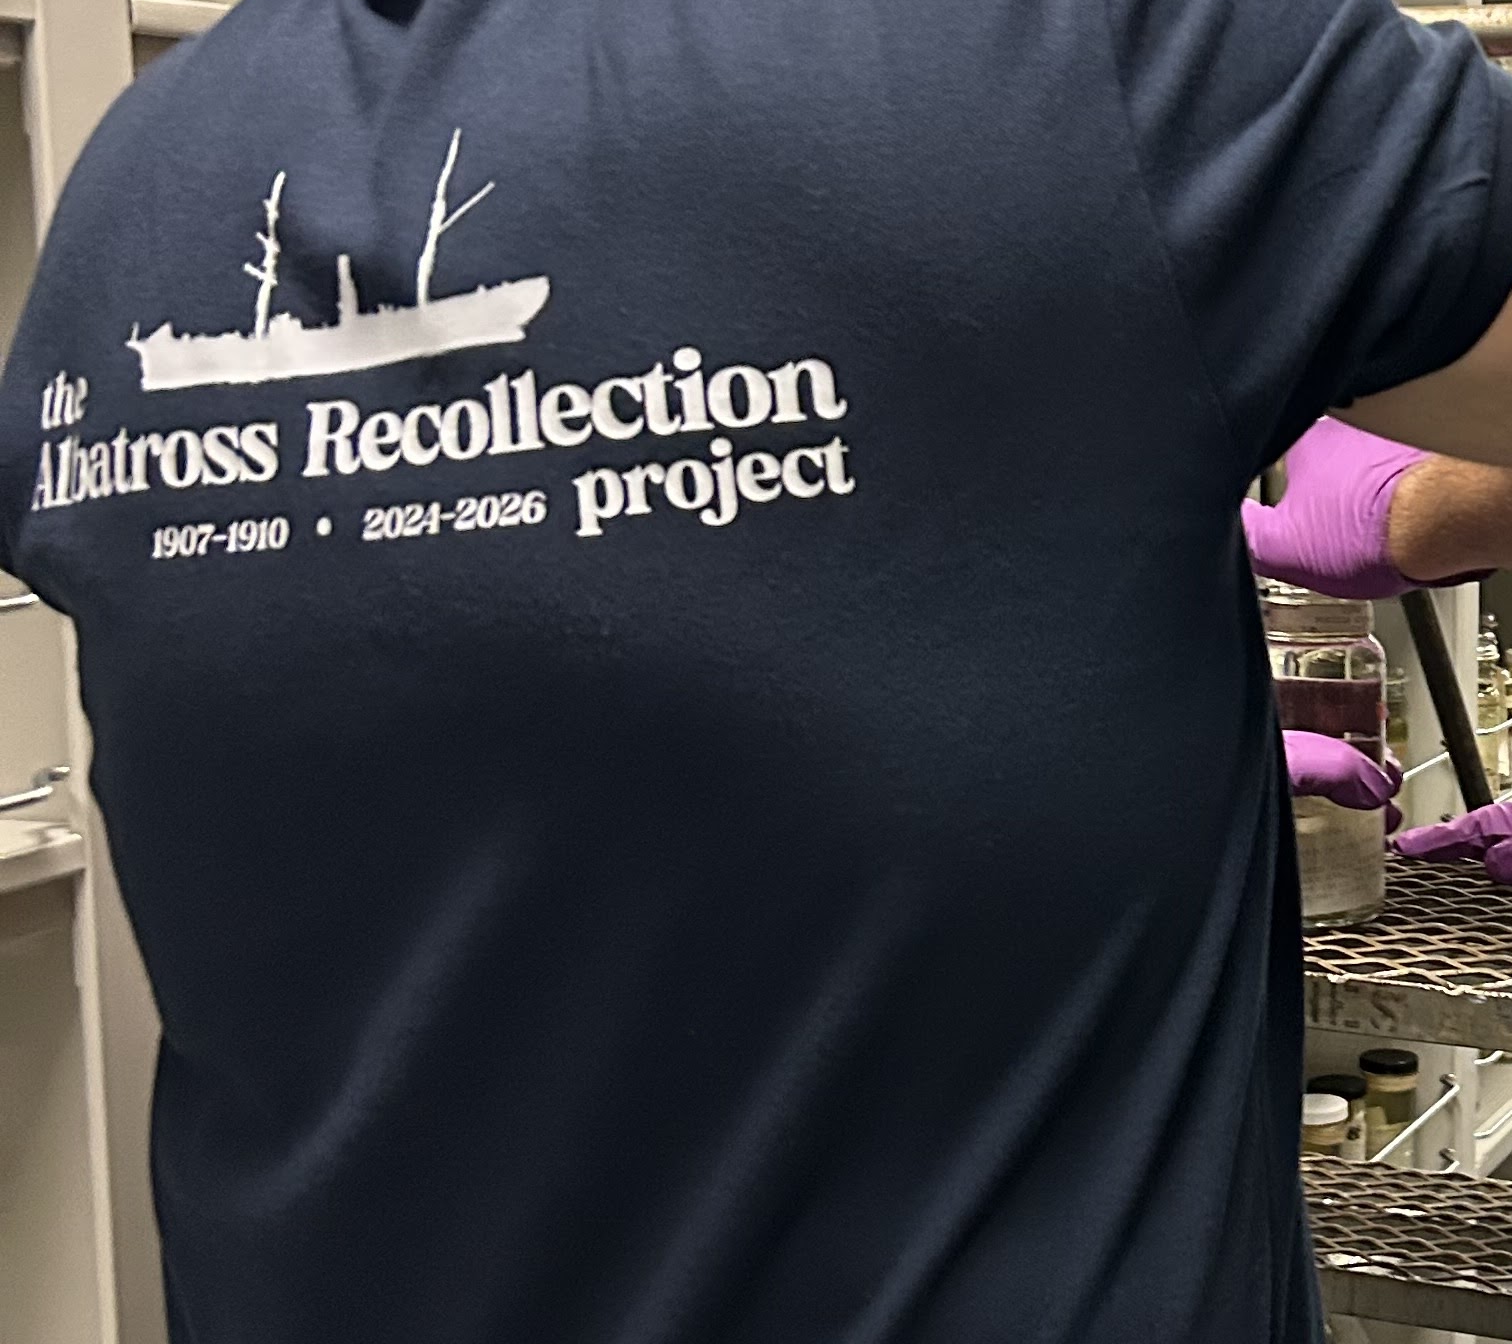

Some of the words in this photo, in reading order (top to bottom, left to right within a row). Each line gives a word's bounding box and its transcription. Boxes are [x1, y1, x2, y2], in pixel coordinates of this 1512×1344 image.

[31, 421, 279, 512] Albatross
[302, 346, 847, 478] Recollection
[41, 369, 89, 430] the
[151, 516, 290, 559] 1907-1910
[361, 490, 547, 541] 2024-2026
[571, 436, 856, 537] project
